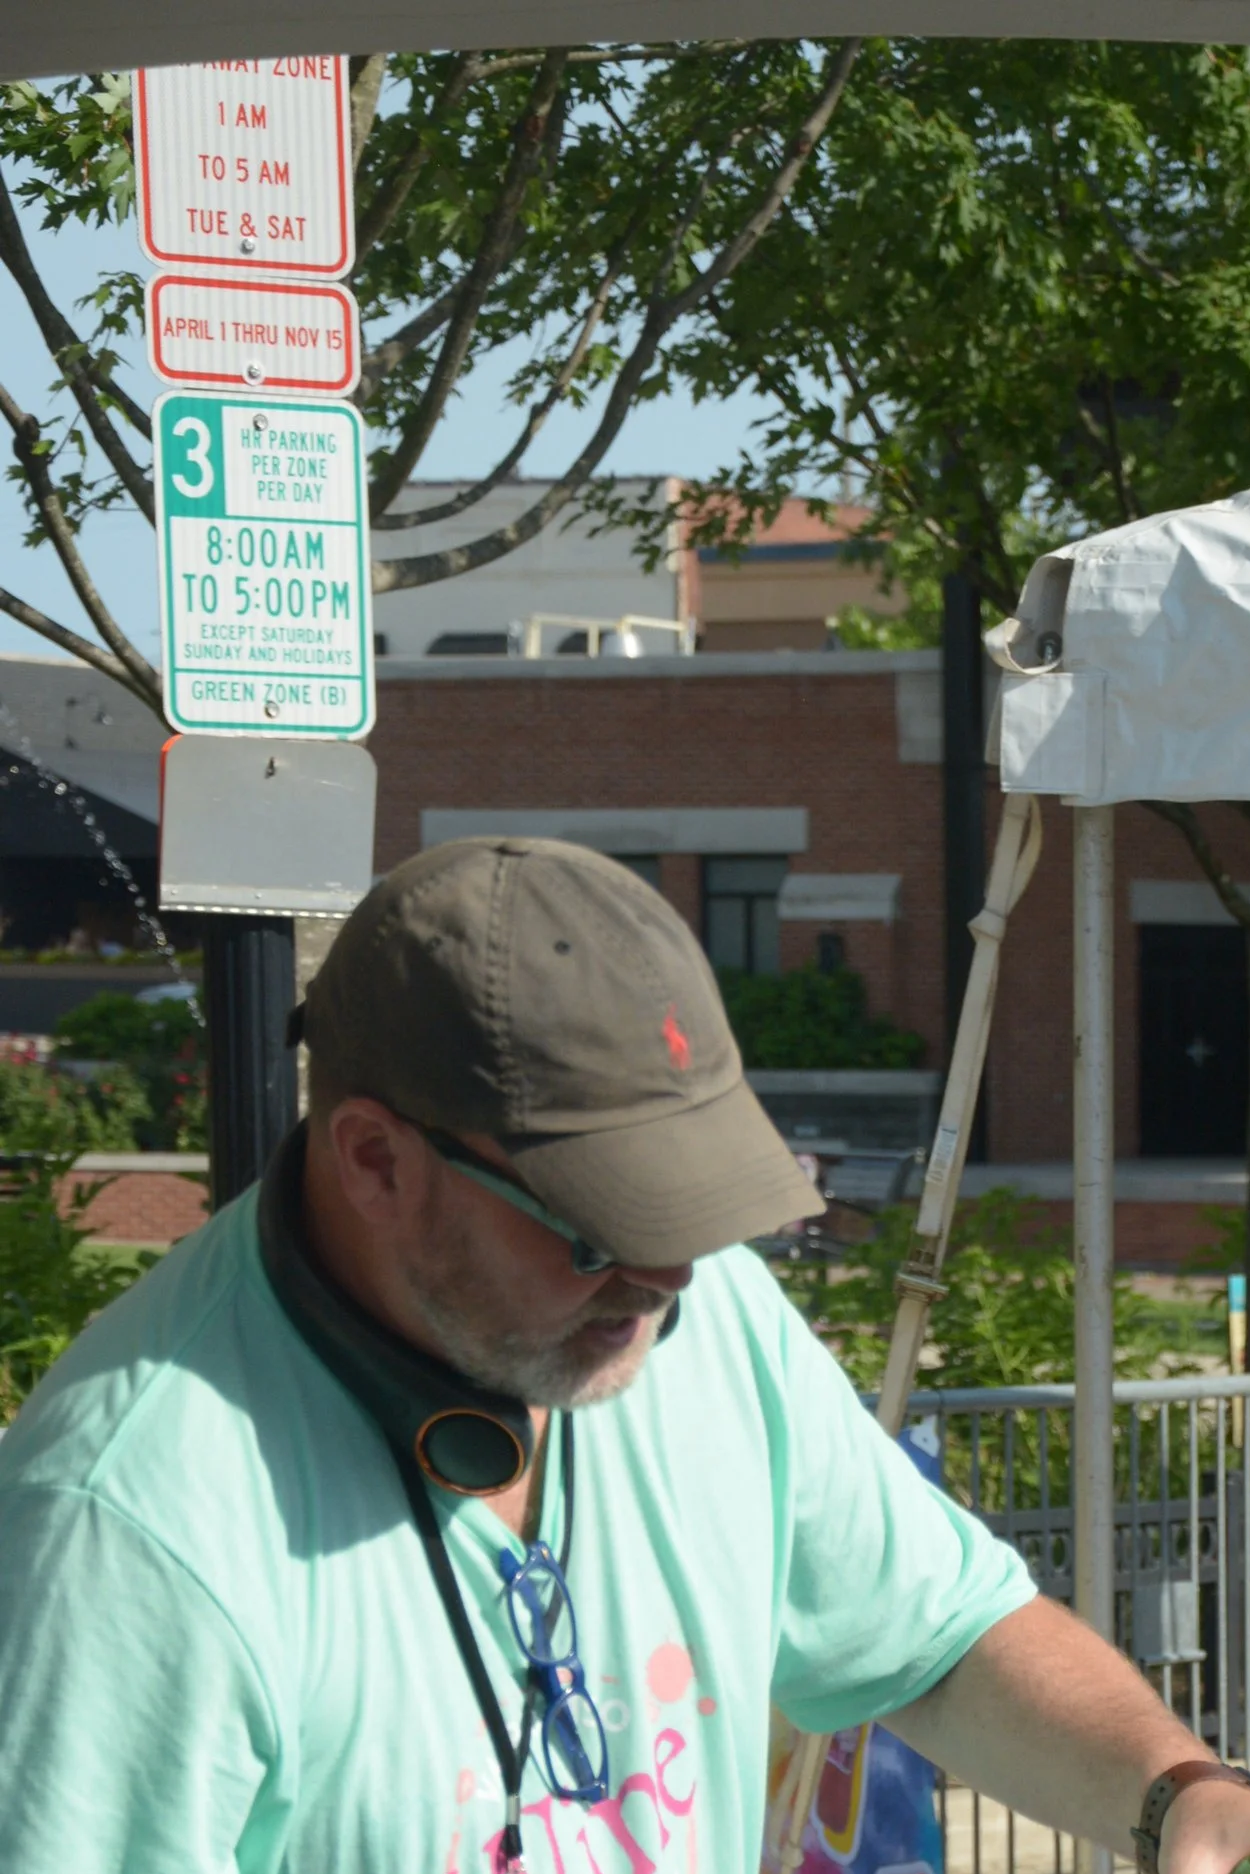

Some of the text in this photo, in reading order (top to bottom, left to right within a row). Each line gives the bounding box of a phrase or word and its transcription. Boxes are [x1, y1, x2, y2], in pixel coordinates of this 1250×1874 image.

[273, 55, 331, 80] ZONE
[218, 101, 267, 129] 1 AM
[198, 155, 290, 186] TO 5 AM
[187, 208, 306, 241] TUE & SAT
[163, 317, 343, 350] APRIL 1 THRU NOV 15
[241, 430, 338, 454] HR PARKING
[171, 416, 215, 499] 3
[252, 455, 327, 479] PER ZONE
[257, 480, 323, 504] PER DAY
[207, 526, 325, 570] 8:00AM
[182, 573, 351, 620] TO 5:00PM
[201, 624, 334, 645] EXCEPT SATURDAY
[184, 643, 352, 666] SUNDAY AND HOLIDAYS
[192, 680, 347, 707] GREEN ZONE (B)
